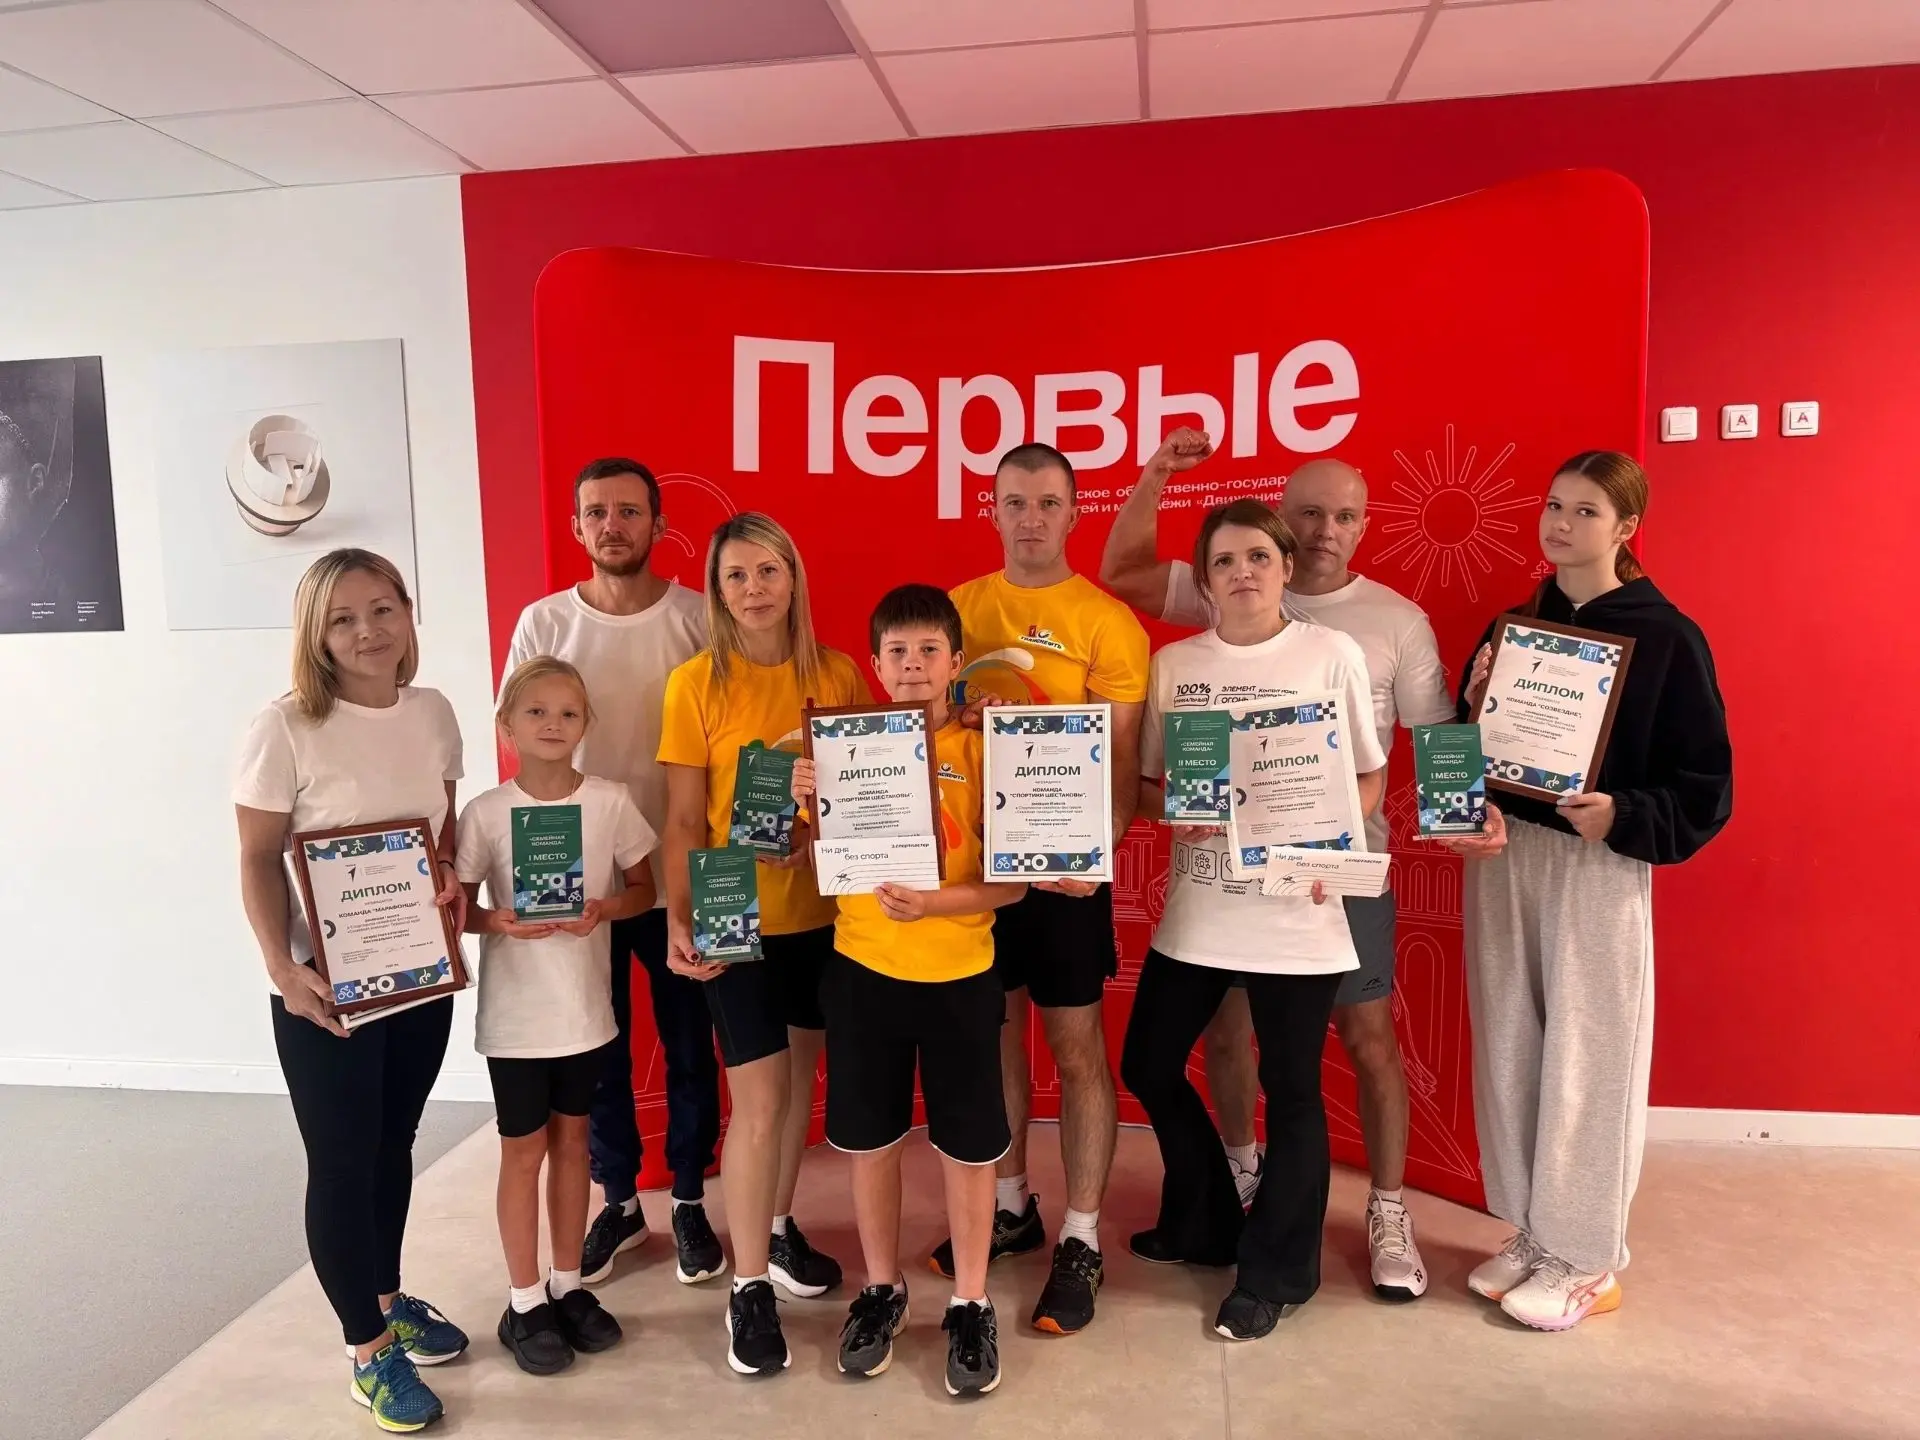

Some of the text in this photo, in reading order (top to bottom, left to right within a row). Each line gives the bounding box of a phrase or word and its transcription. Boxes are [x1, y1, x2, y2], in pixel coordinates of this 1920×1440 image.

[733, 335, 1360, 519] Первые
[1177, 683, 1211, 695] 100%
[1513, 678, 1584, 701] ДИПЛОМ
[1506, 696, 1537, 707] КОМАНДА
[1252, 754, 1319, 772] ДИПЛОМ
[839, 765, 906, 782] ДИПЛОМ
[1014, 766, 1080, 777] ДИПЛОМ
[752, 792, 782, 802] МЕСТО
[533, 853, 567, 861] МЕСТО
[844, 853, 858, 861] без
[341, 881, 411, 902] ДИПЛОМ
[713, 893, 746, 903] МЕСТО
[339, 910, 372, 918] КОМАНДА
